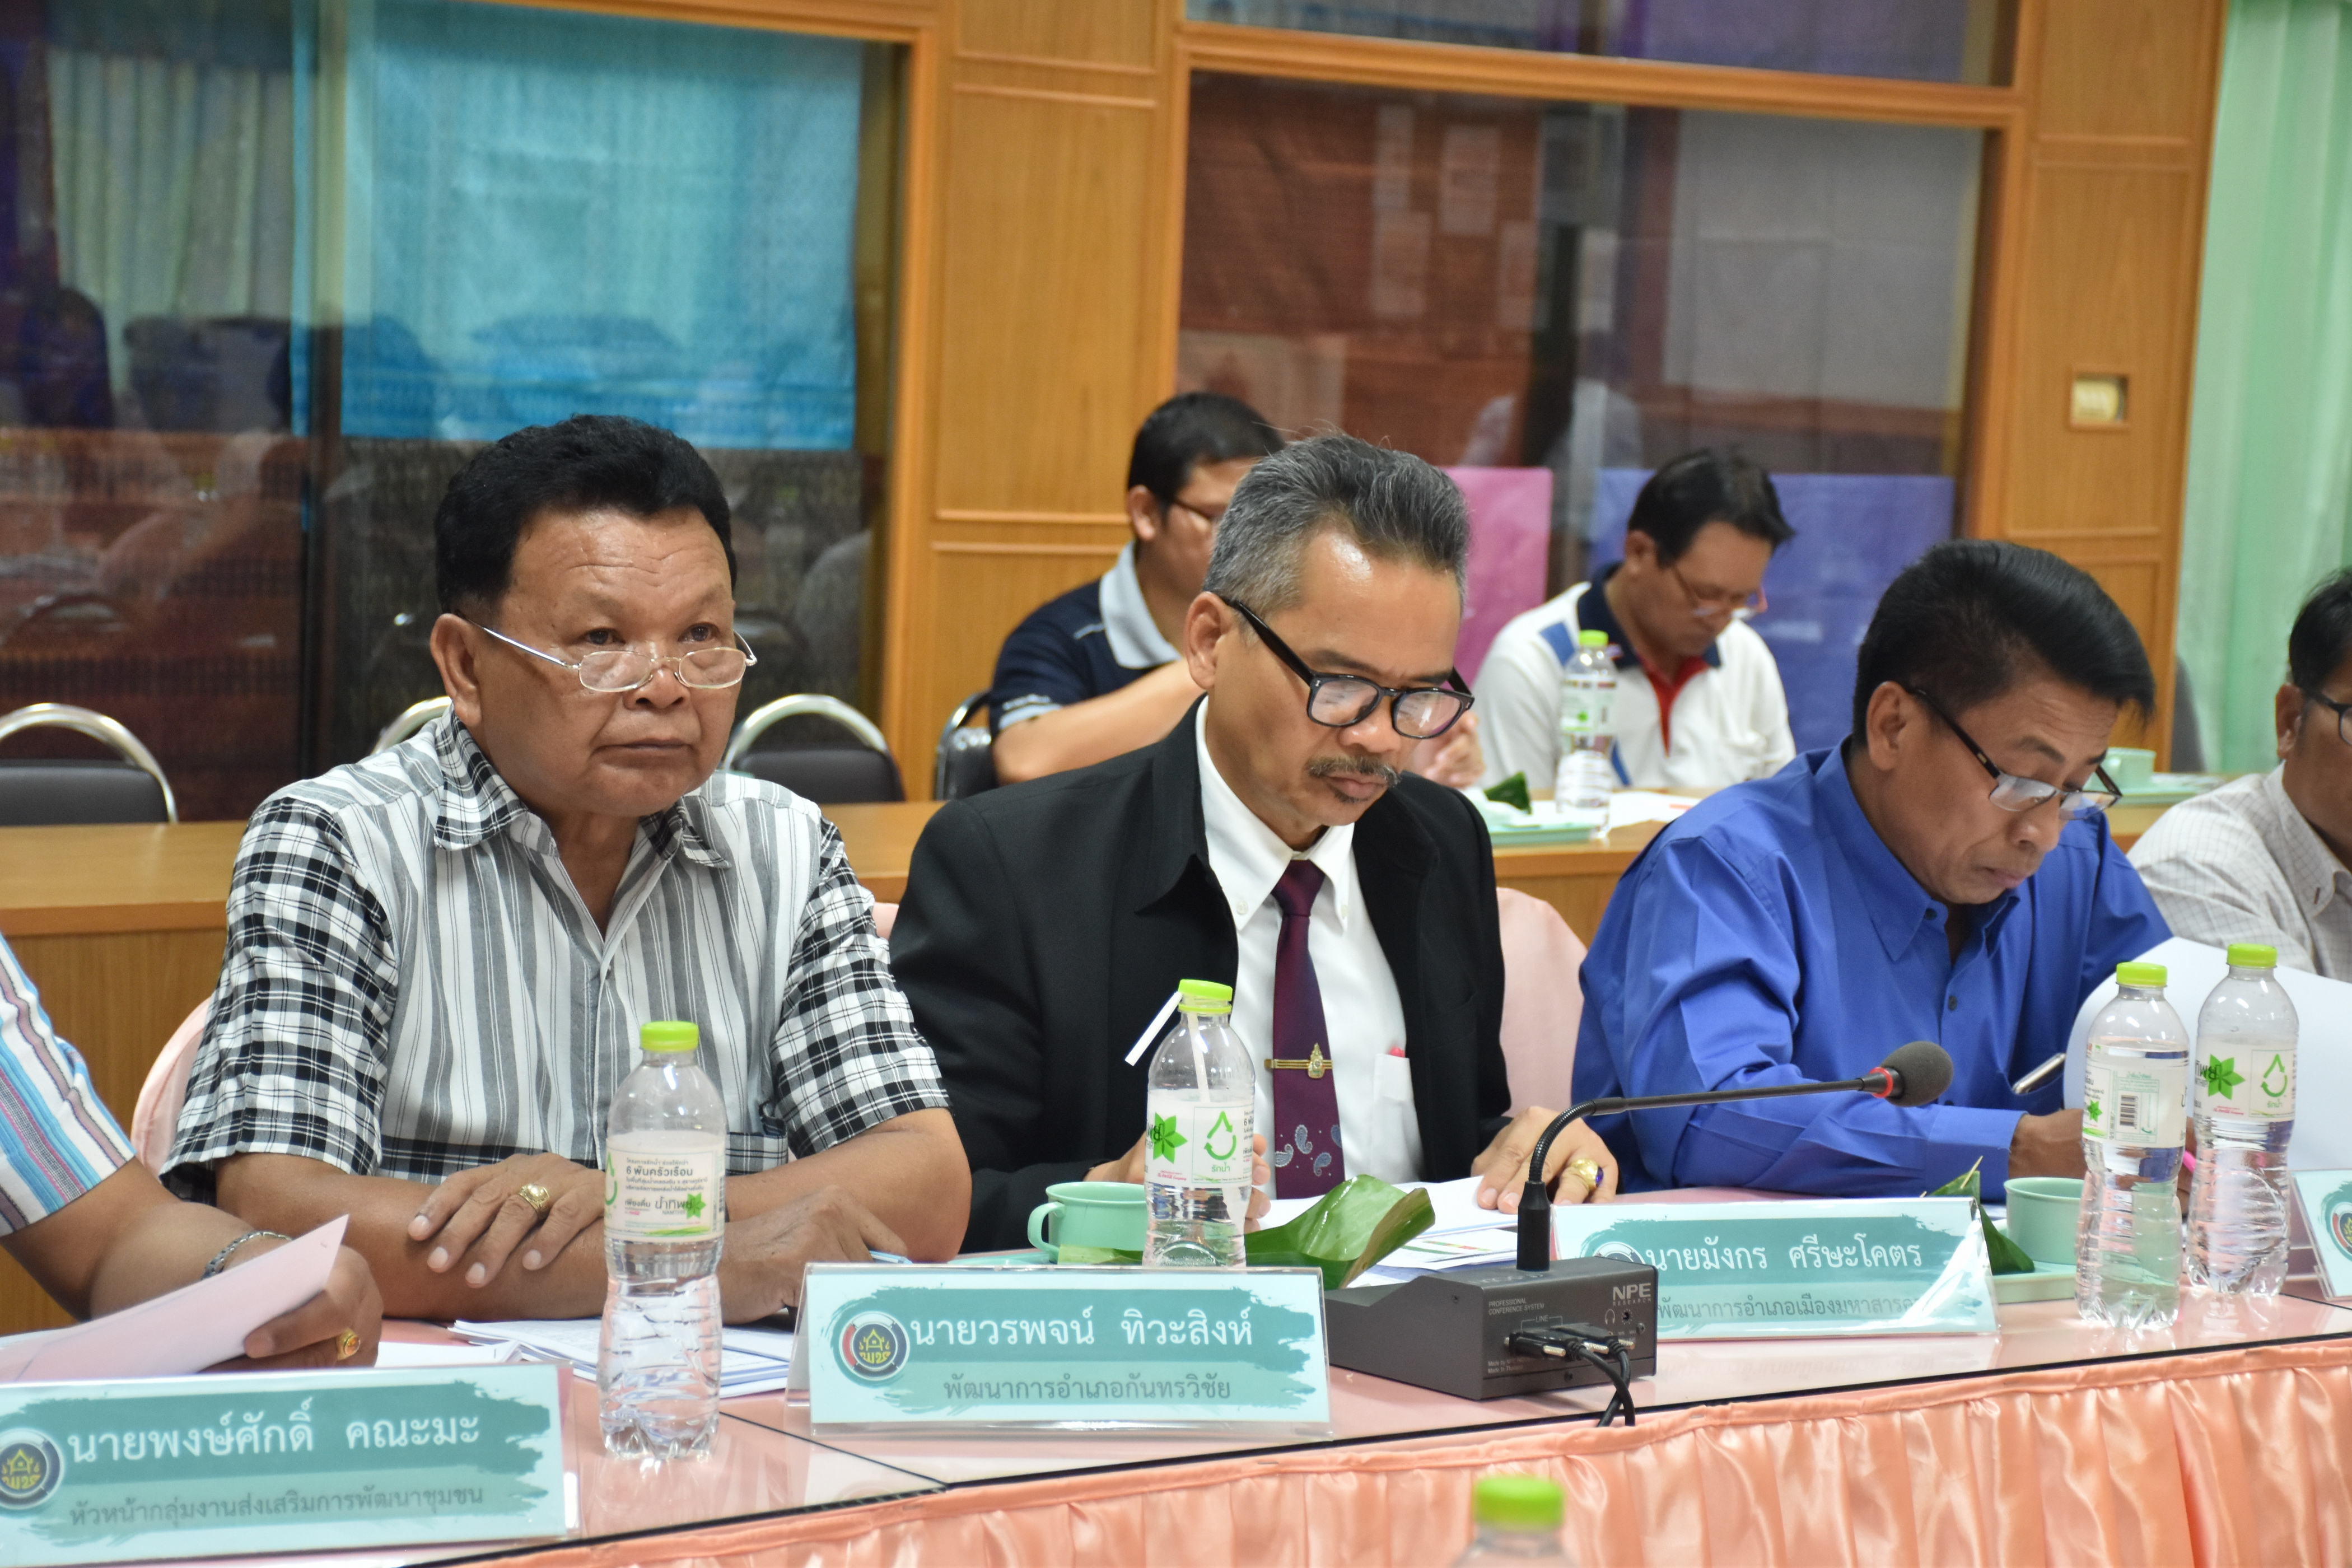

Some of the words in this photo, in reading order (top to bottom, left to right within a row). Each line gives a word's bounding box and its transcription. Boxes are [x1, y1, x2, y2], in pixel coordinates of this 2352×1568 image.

[626, 1165, 632, 1175] 6
[634, 1164, 693, 1177] พันครัวเรือน
[1211, 1161, 1231, 1173] รักน้ำ
[1646, 1236, 1768, 1271] นายมังกร
[1789, 1233, 1923, 1268] ศรีษะโคตร
[1613, 1282, 1651, 1301] NPE
[1488, 1298, 1527, 1308] PROFESSIONAL
[1488, 1305, 1523, 1315] CONFERENCE
[1524, 1303, 1544, 1311] SYSTEM
[1613, 1298, 1652, 1306] RESEARCH
[1658, 1293, 1919, 1319] พัฒนาการอำเภอเมืองมหาสารค
[910, 1305, 1095, 1346] นายวรพจน์
[1121, 1305, 1252, 1346] ทิวะสิงห์
[1536, 1314, 1548, 1323] LINE
[943, 1373, 1231, 1399] พัฒนาการอำเภอกันทรวิชัย
[67, 1397, 315, 1463] นายพงษ์ศักดิ์
[346, 1415, 480, 1450] คณะมะ
[69, 1485, 484, 1528] หัวหน้ากลุ่มงานส่งเสริมการพัฒนาชุมชน
